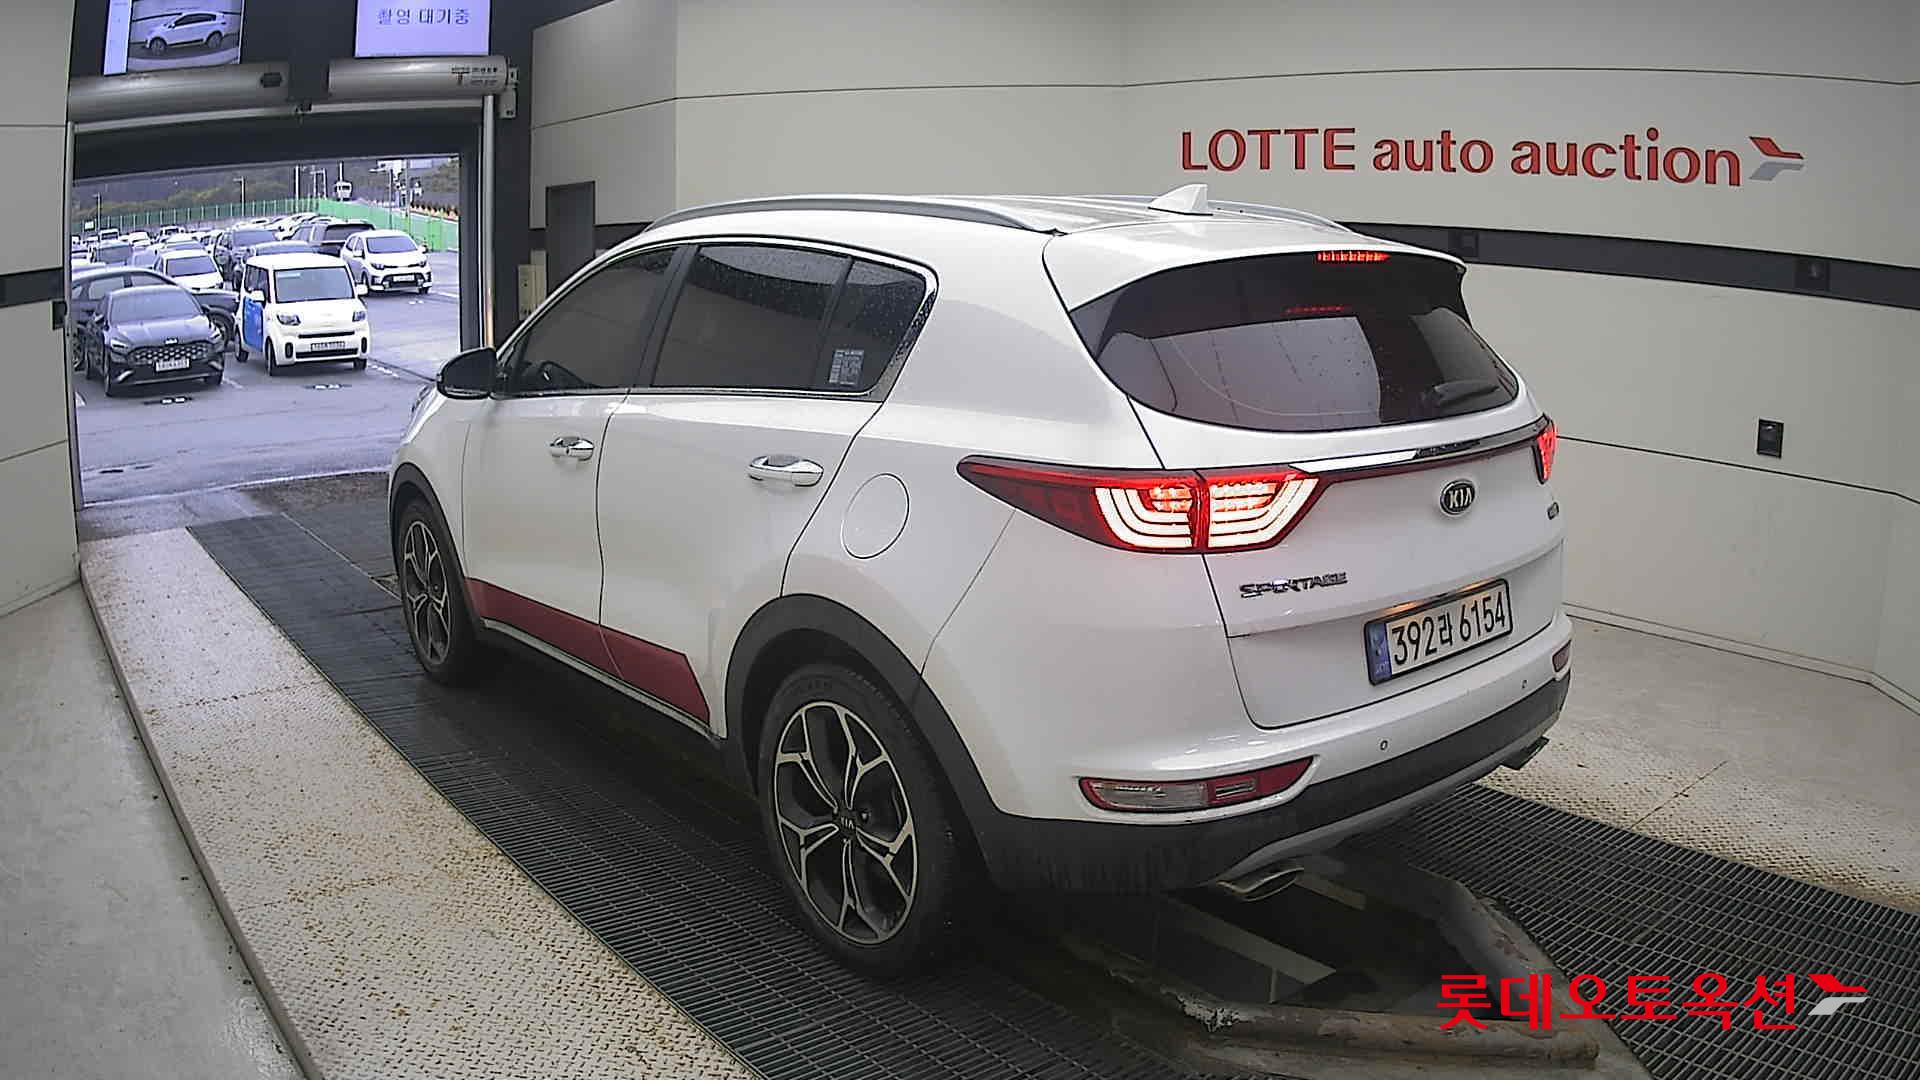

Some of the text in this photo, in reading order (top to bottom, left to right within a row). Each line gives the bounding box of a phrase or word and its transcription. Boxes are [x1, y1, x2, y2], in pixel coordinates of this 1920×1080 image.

[419, 8, 469, 25] 대기중
[1182, 127, 1741, 186] LOTTE auto auction
[1449, 487, 1472, 509] KIA
[1460, 591, 1506, 642] 6154
